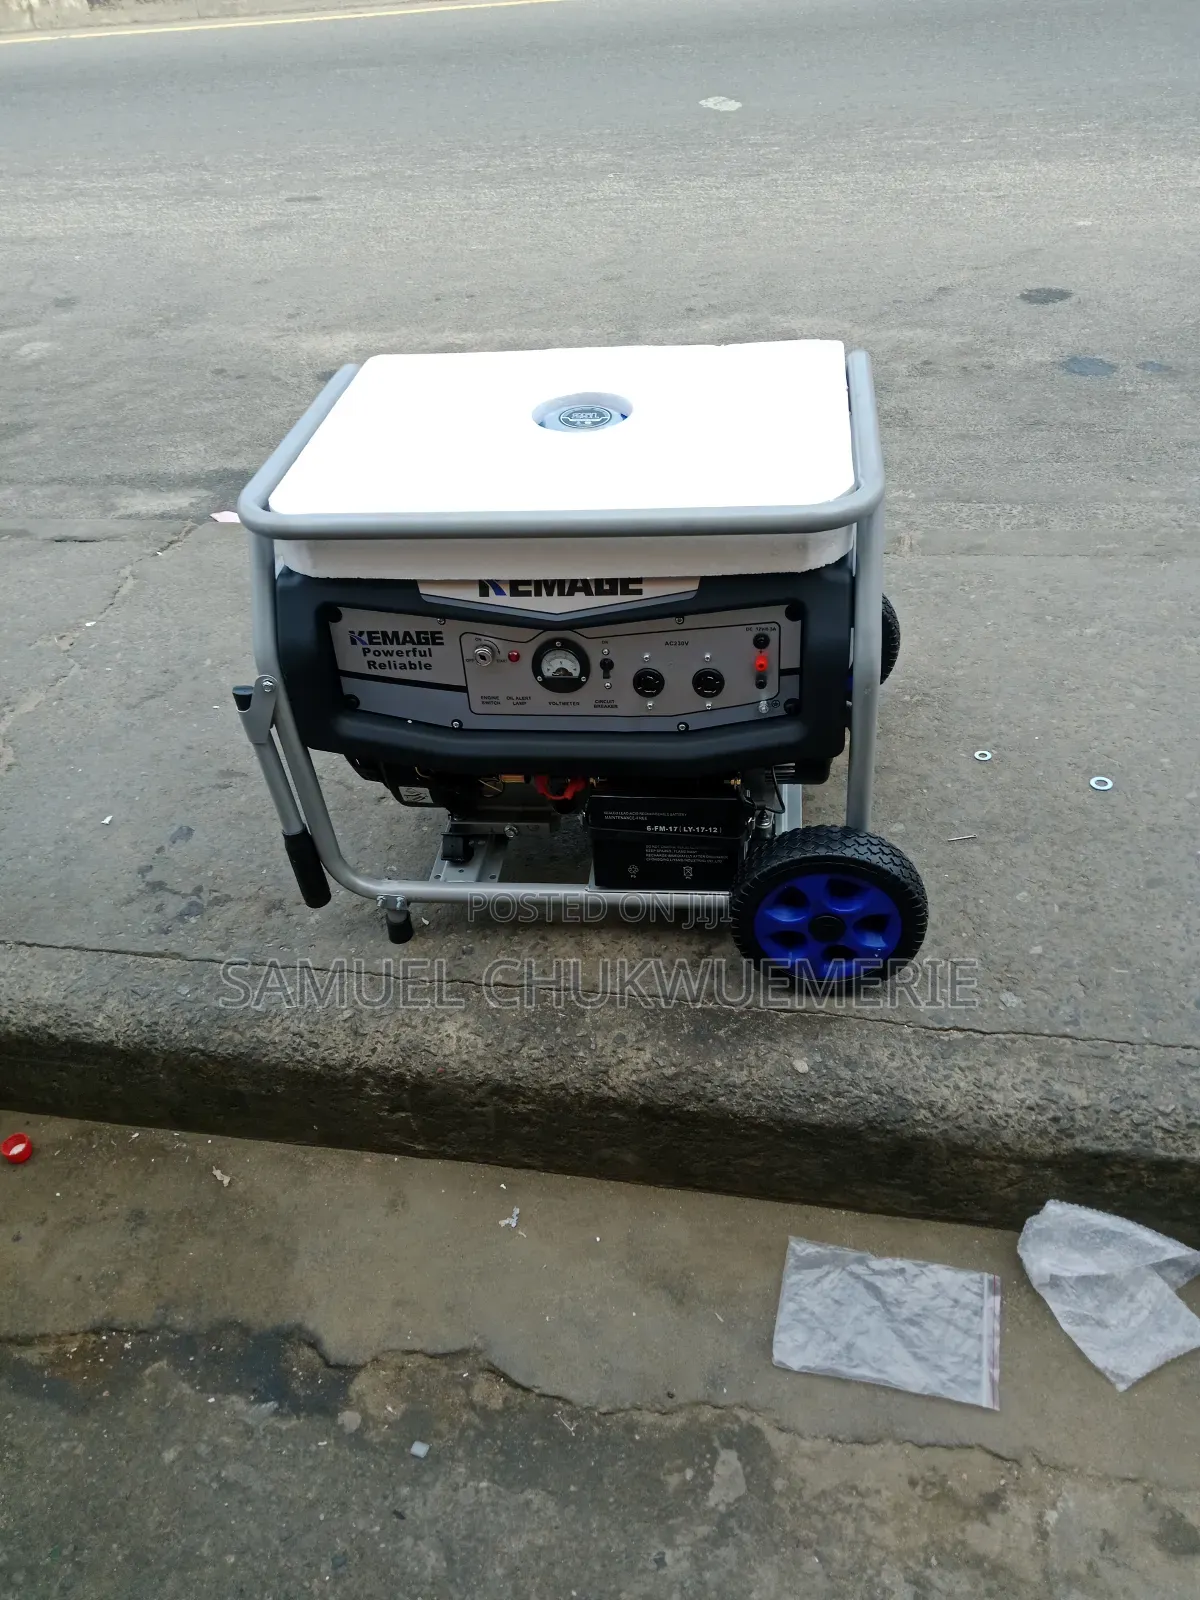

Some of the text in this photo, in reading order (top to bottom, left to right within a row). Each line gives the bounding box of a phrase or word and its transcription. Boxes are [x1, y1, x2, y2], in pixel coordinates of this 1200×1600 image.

[479, 578, 643, 597] KEMAGE
[348, 630, 445, 646] KEMAGE
[362, 647, 433, 658] Powerful
[366, 660, 433, 671] Reliable
